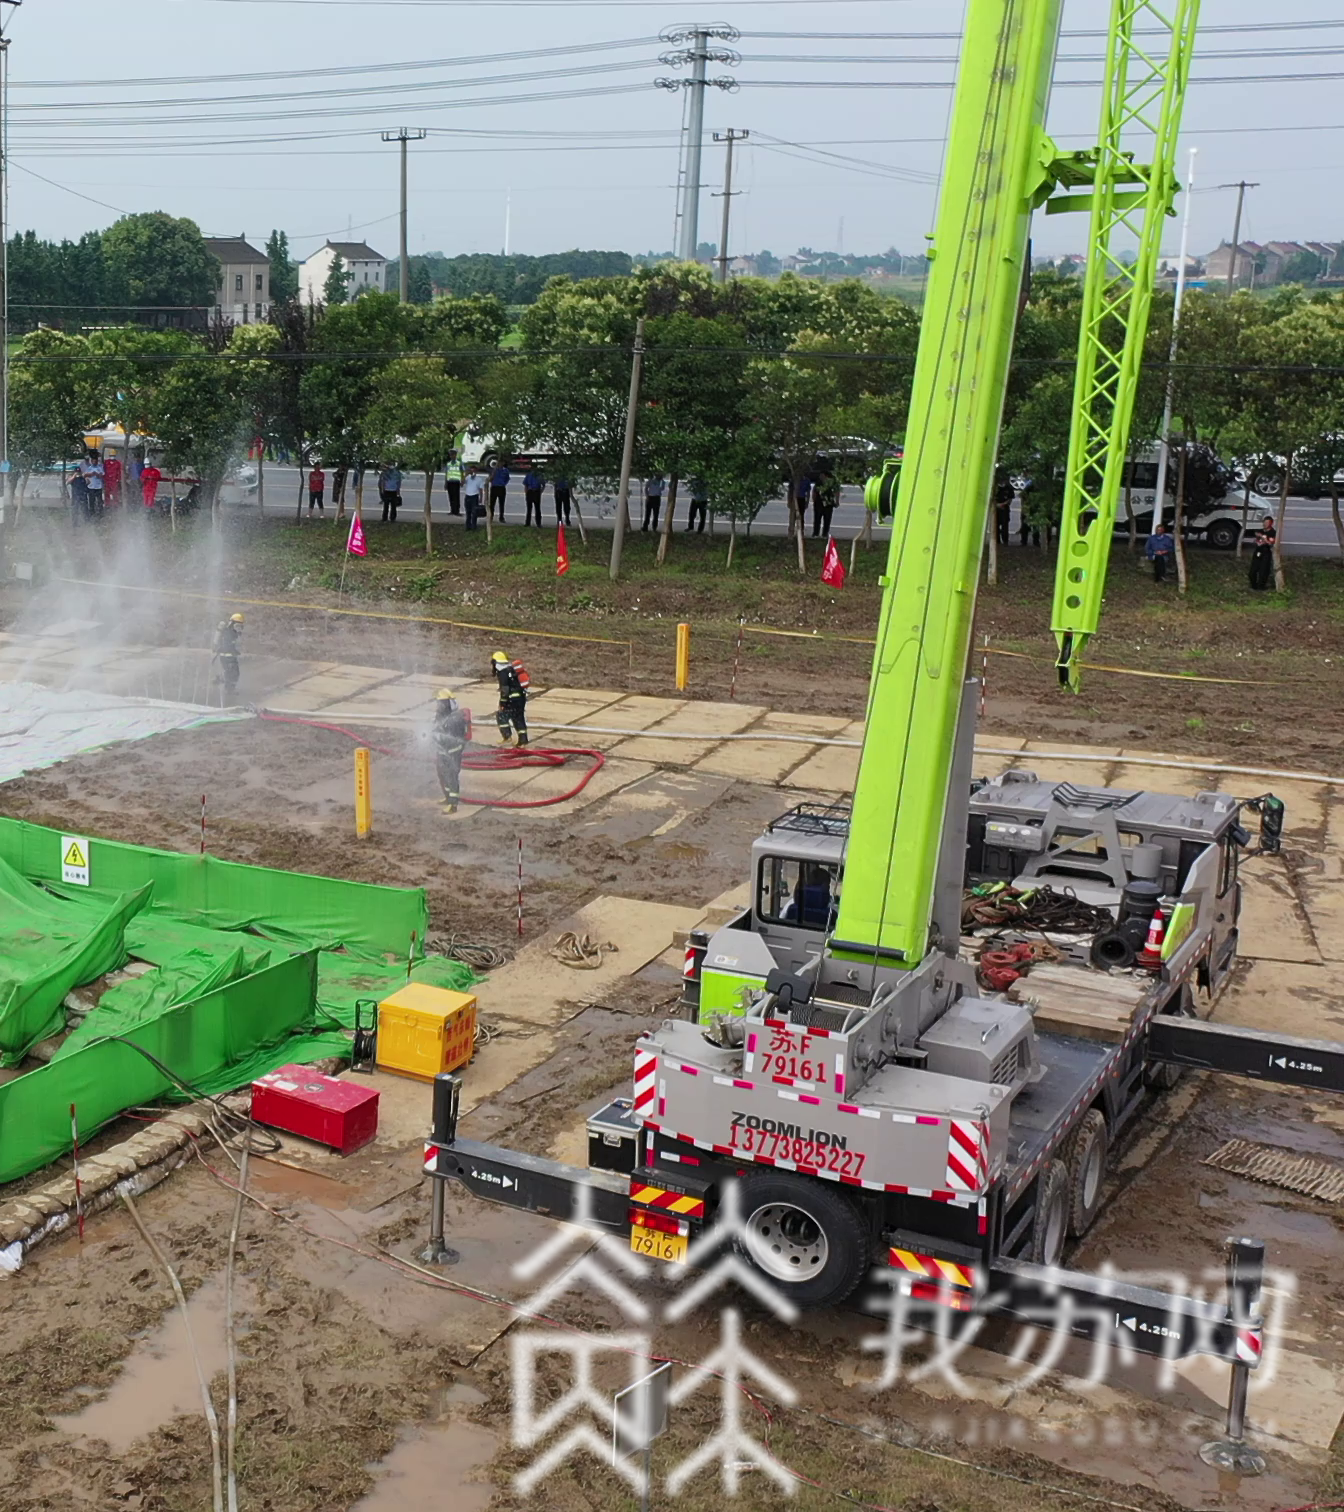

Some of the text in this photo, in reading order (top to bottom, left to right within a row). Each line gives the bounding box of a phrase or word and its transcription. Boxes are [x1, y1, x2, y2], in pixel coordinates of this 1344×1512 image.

[769, 1027, 813, 1055] 苏F
[761, 1053, 827, 1083] 79161
[1288, 1060, 1323, 1073] 4.25m
[731, 1111, 848, 1150] ZOOMLION
[728, 1124, 866, 1177] 13773825227
[470, 1165, 501, 1185] 4.25m
[633, 1235, 682, 1262] 79161
[1139, 1322, 1181, 1340] 4.25m
